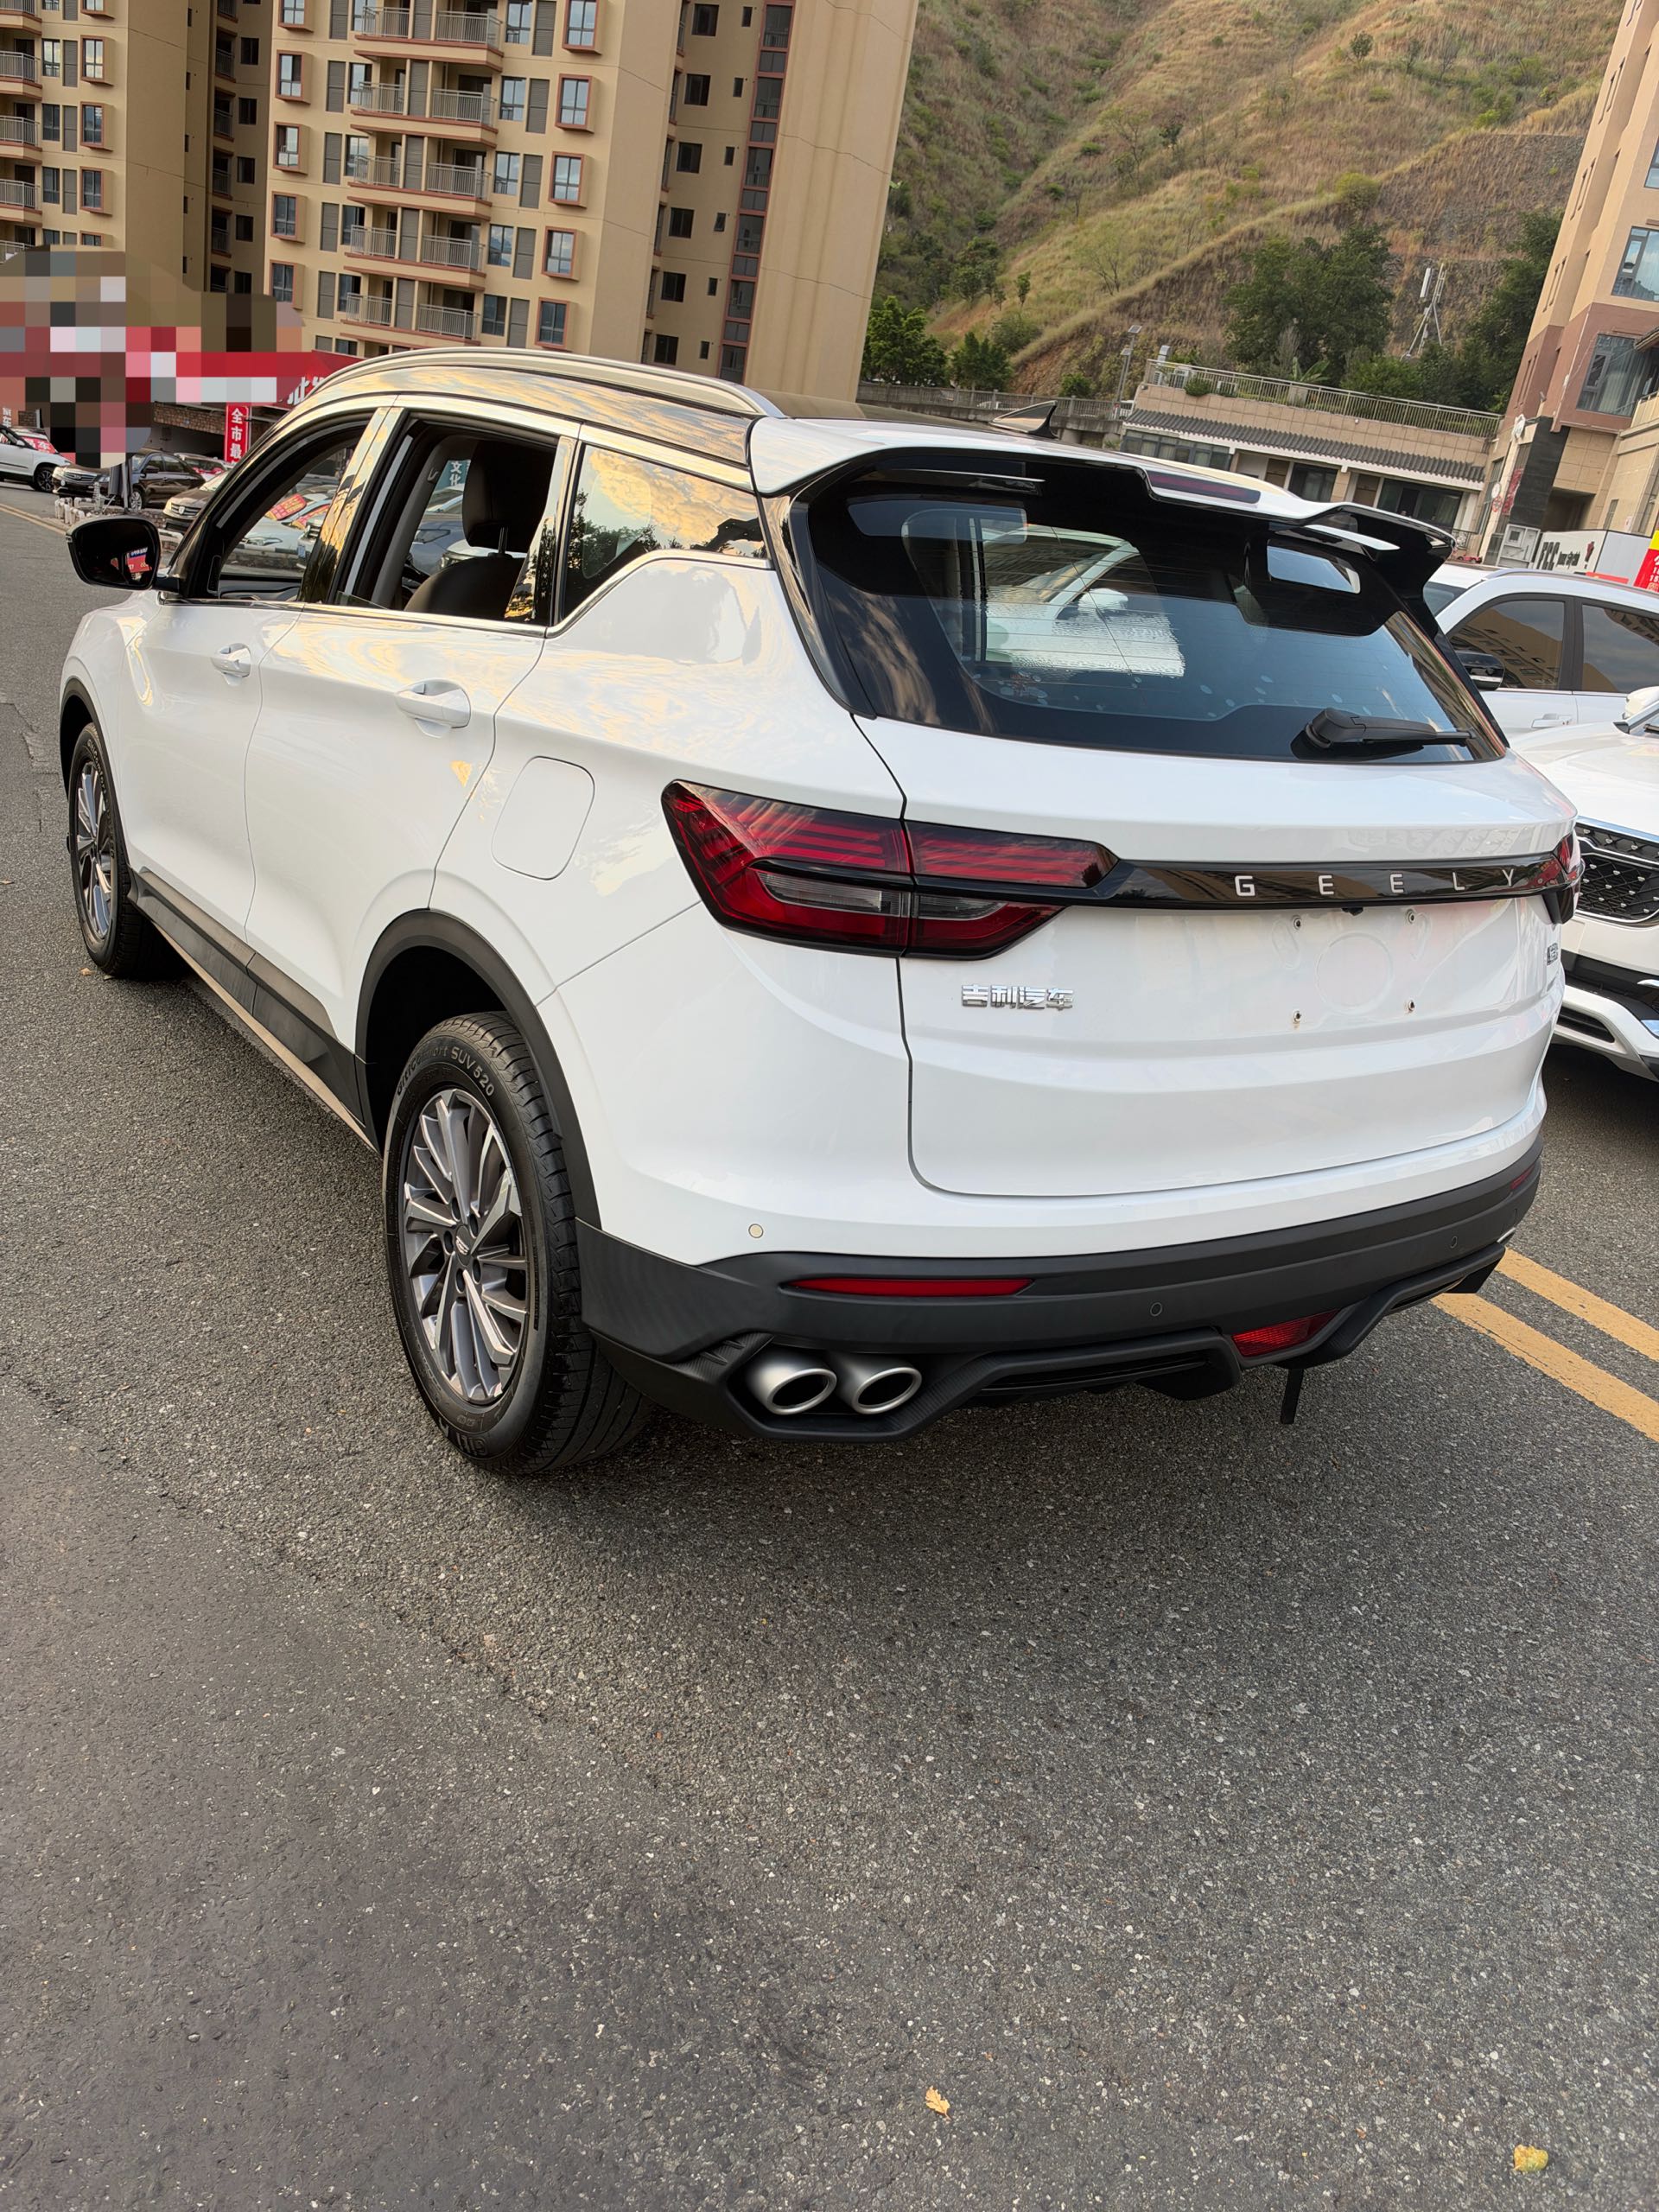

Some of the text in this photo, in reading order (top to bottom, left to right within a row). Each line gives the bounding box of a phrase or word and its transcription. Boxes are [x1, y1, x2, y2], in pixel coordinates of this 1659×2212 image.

[230, 407, 245, 465] 全市最
[449, 461, 463, 486] 文化
[1235, 868, 1515, 897] GEELY
[962, 985, 1073, 1011] 吉利汽车
[451, 1046, 476, 1070] SUV
[473, 1066, 495, 1096] 520
